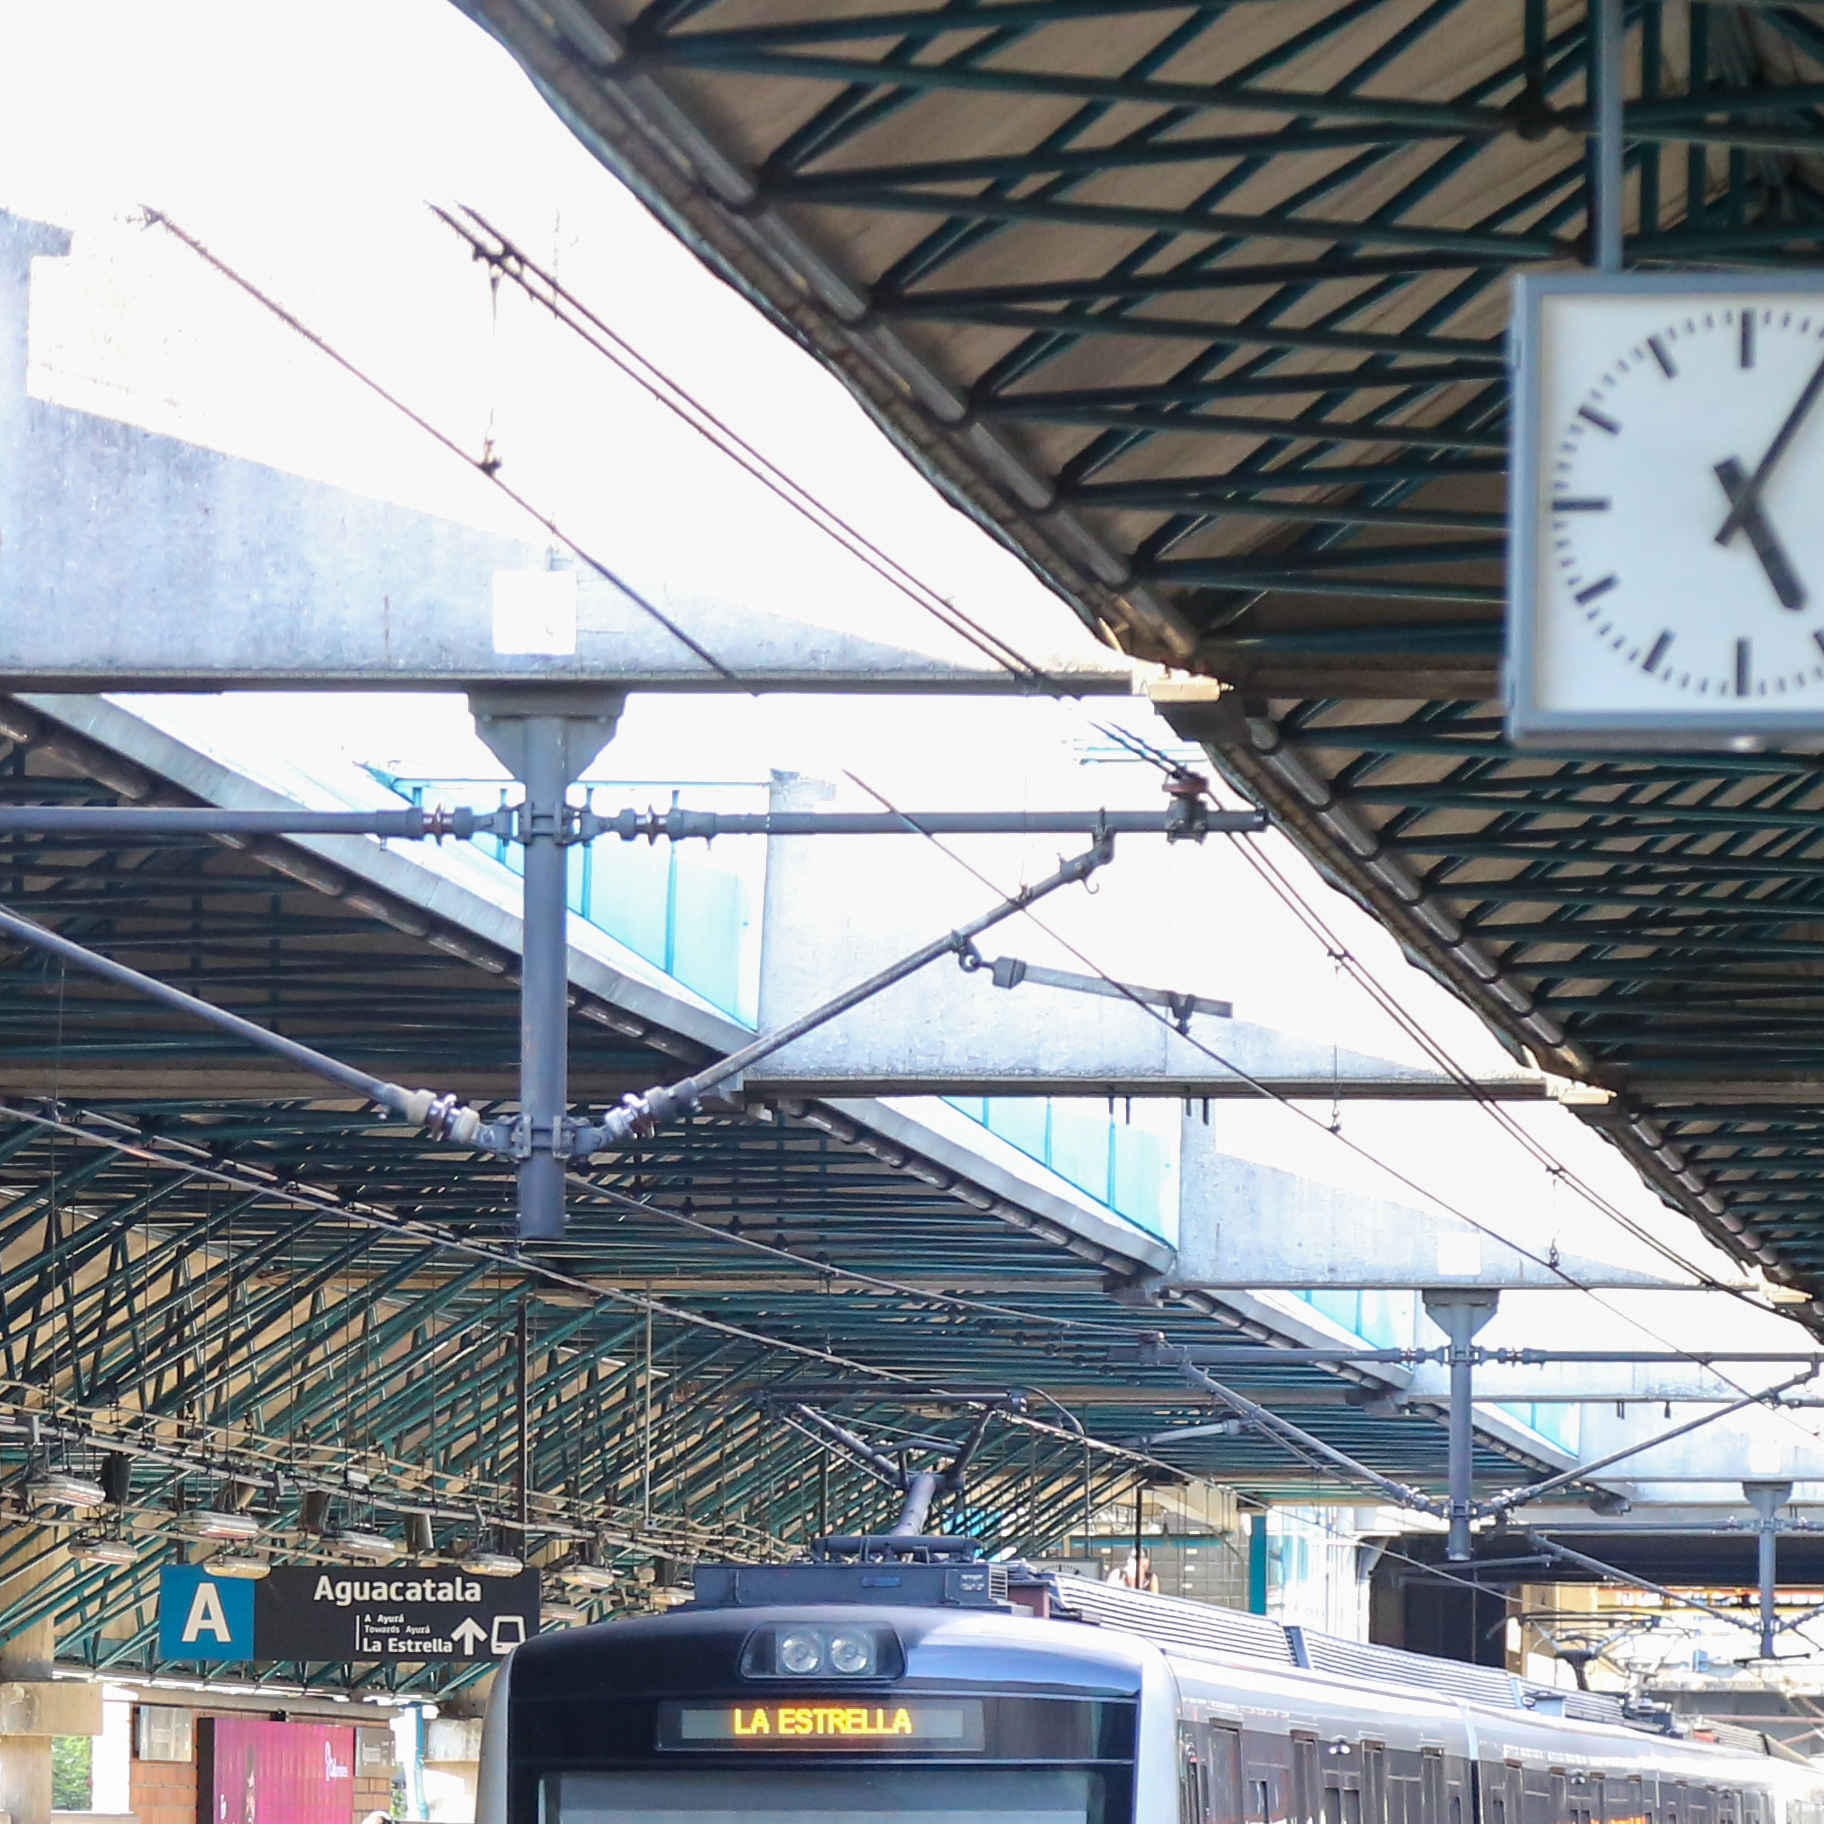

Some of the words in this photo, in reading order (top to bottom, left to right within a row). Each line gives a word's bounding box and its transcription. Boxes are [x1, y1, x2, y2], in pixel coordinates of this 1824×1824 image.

[313, 1575, 482, 1606] Aguacatala
[181, 1582, 232, 1642] A
[364, 1613, 372, 1623] A
[377, 1613, 405, 1624] Ayurá
[364, 1625, 401, 1633] Towards
[405, 1625, 431, 1635] Ayurá
[363, 1637, 382, 1653] La
[388, 1637, 453, 1653] Estrella
[734, 1708, 770, 1734] LA
[778, 1708, 913, 1734] ESTRELLA
